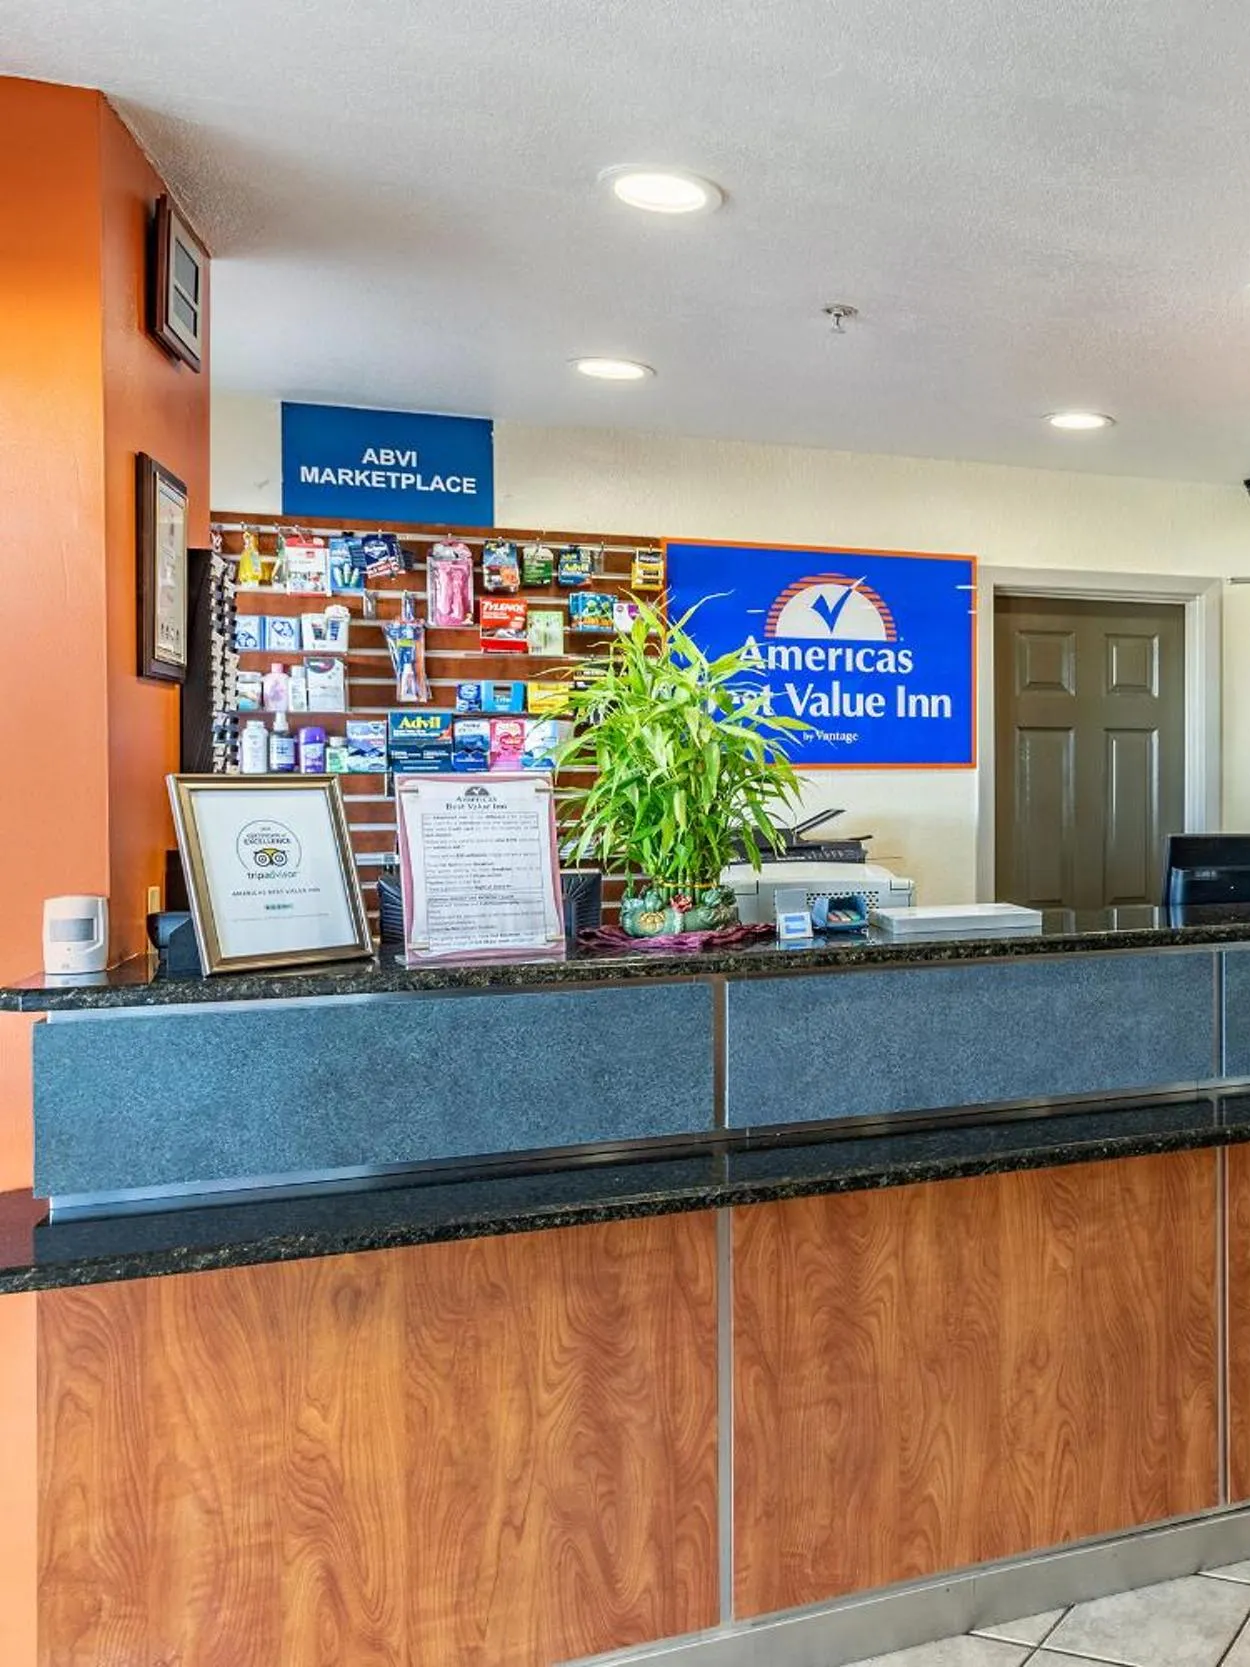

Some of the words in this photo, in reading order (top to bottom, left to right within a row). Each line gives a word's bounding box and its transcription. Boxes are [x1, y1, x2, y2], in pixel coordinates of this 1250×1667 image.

[361, 447, 418, 468] ABVI
[300, 465, 477, 494] MARKETPLACE
[738, 635, 914, 675] Americas
[784, 680, 886, 718] Value
[896, 685, 953, 718] Inn
[398, 716, 441, 729] Advil
[816, 731, 859, 744] Vantage
